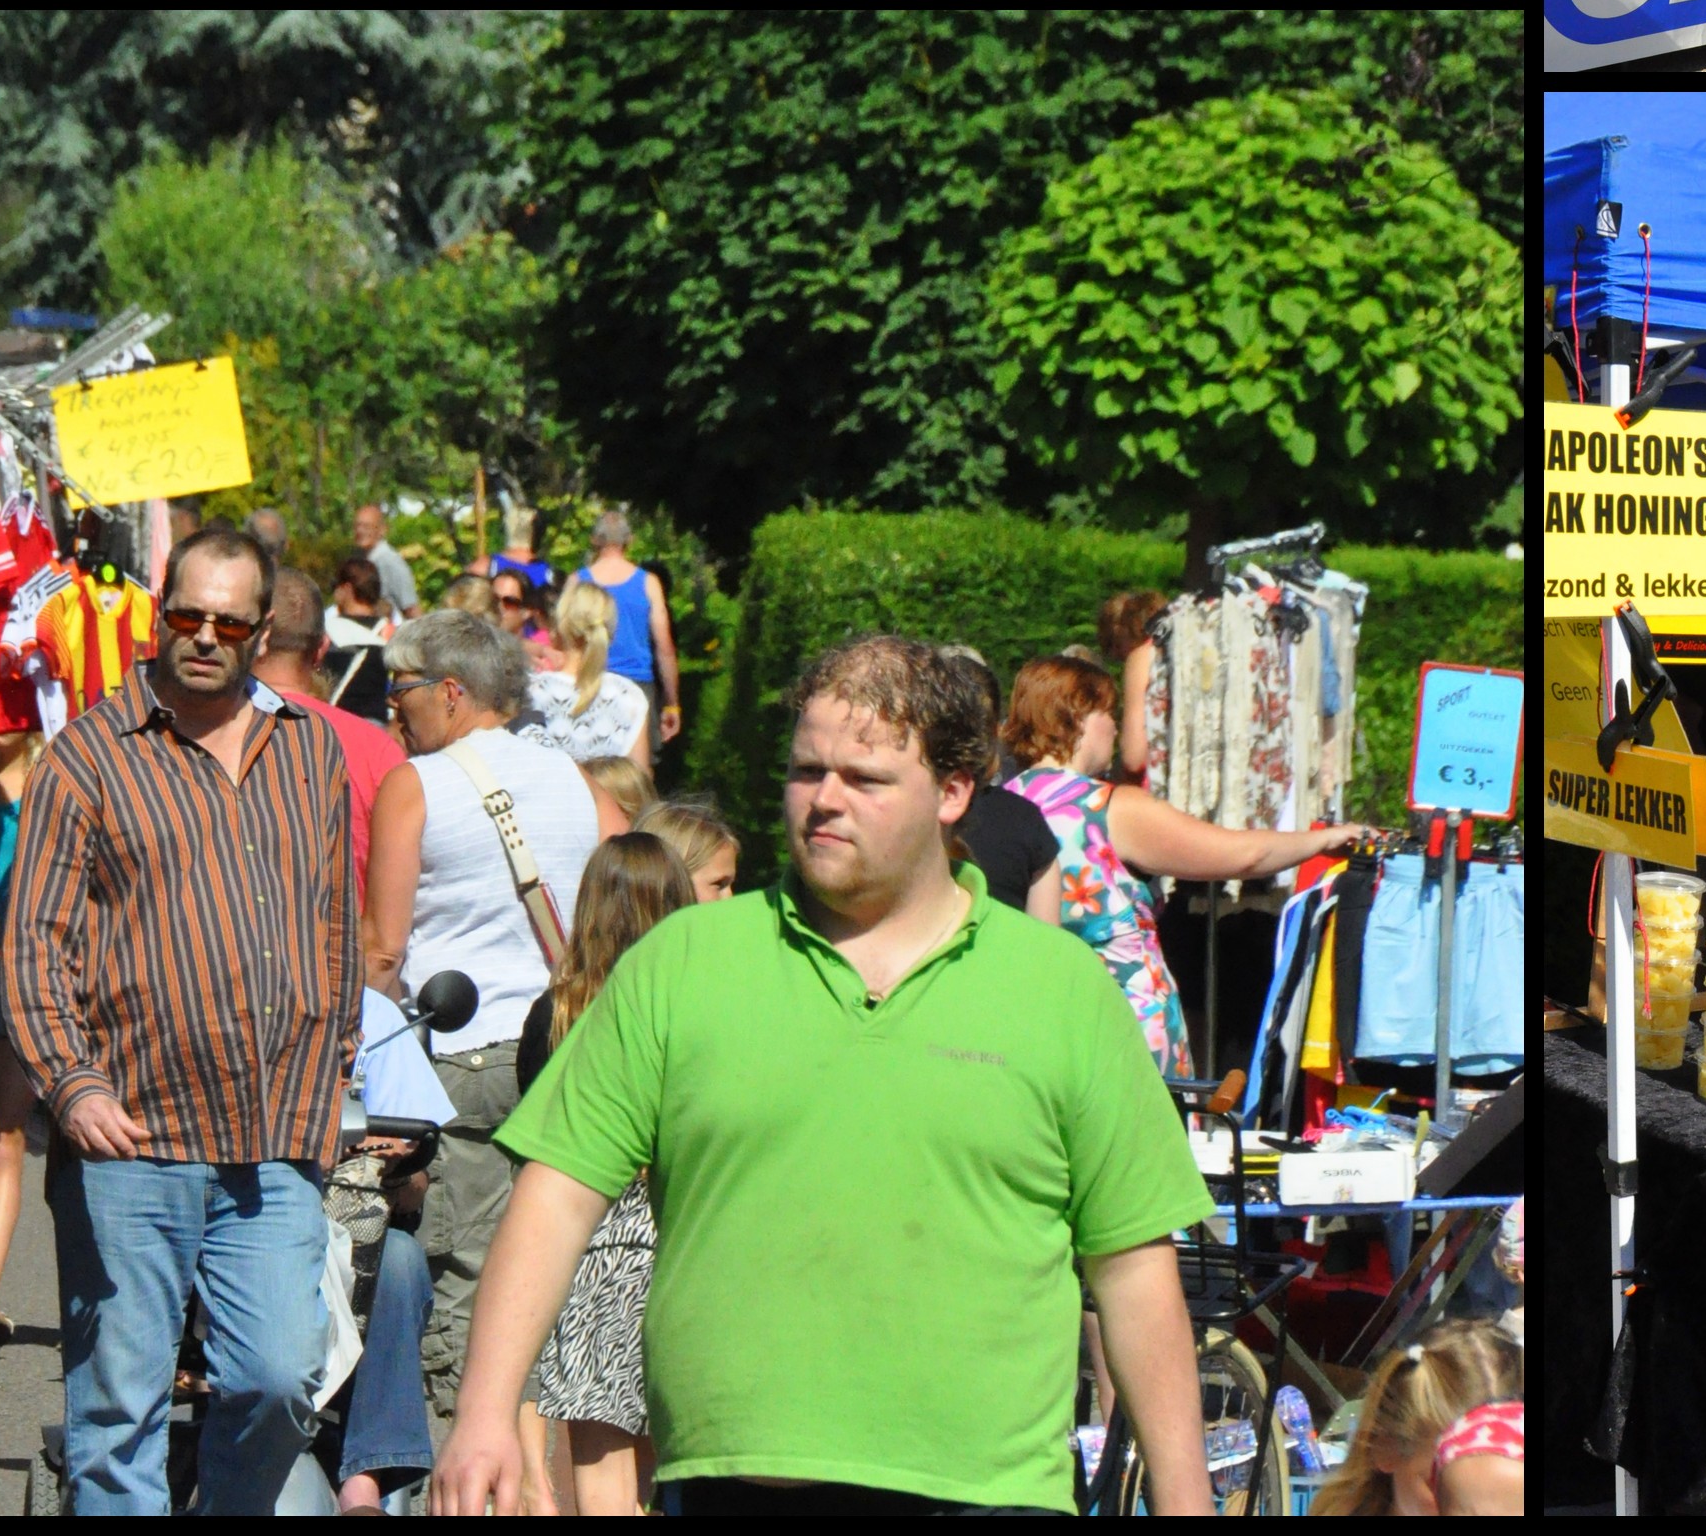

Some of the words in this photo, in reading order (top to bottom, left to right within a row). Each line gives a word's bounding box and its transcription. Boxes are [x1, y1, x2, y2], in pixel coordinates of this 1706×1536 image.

[127, 459, 151, 485] €
[1437, 685, 1472, 712] SPORT
[1551, 682, 1592, 701] Geen
[1469, 711, 1505, 722] OUTLET
[1440, 743, 1493, 754] UITZOEKEN
[1439, 765, 1453, 782] €
[1463, 768, 1492, 791] 3,-
[1548, 769, 1609, 817] SUPER
[1615, 782, 1686, 835] LEKKER
